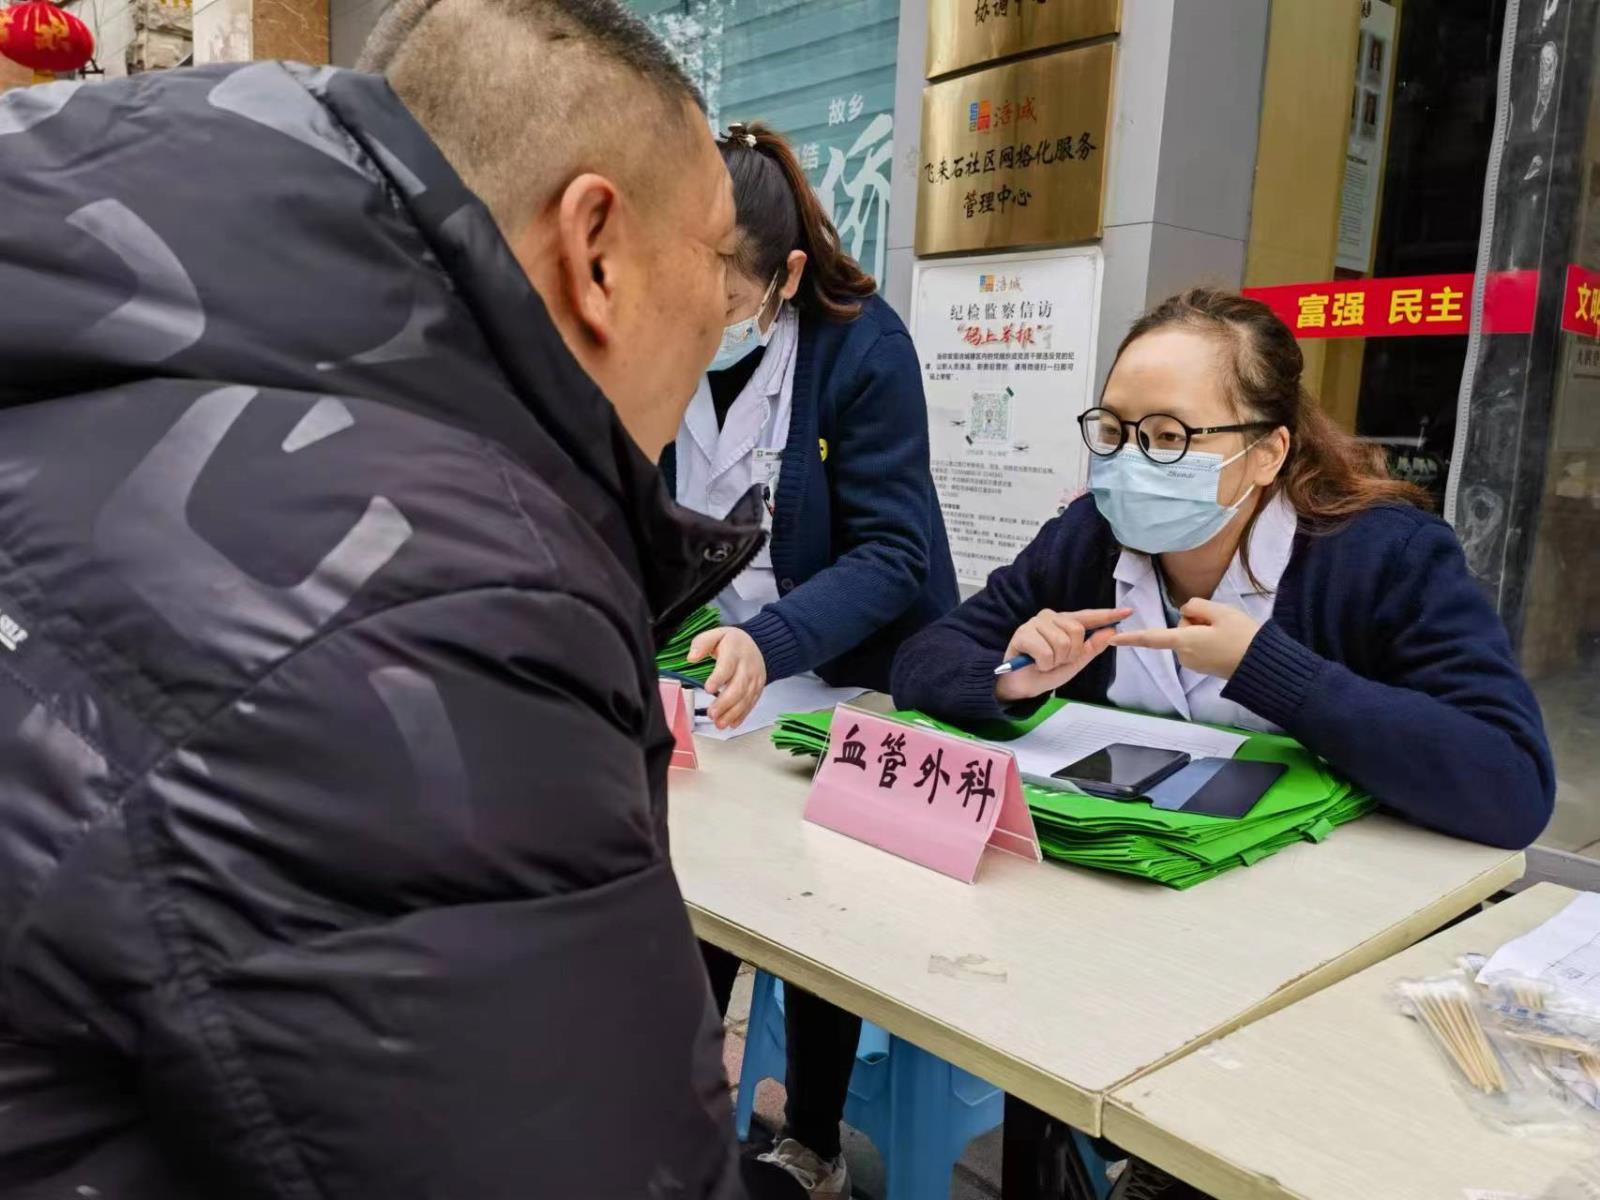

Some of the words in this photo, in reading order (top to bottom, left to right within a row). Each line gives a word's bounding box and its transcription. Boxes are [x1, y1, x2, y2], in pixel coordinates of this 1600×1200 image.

[828, 94, 863, 126] 故乡
[924, 132, 1096, 184] 飞来石社区网格化服务
[963, 184, 1032, 219] 管理中心
[949, 300, 1053, 321] 纪检监察信访
[1296, 291, 1365, 329] 富强
[1388, 286, 1464, 324] 民主
[833, 724, 995, 822] 血管外科
